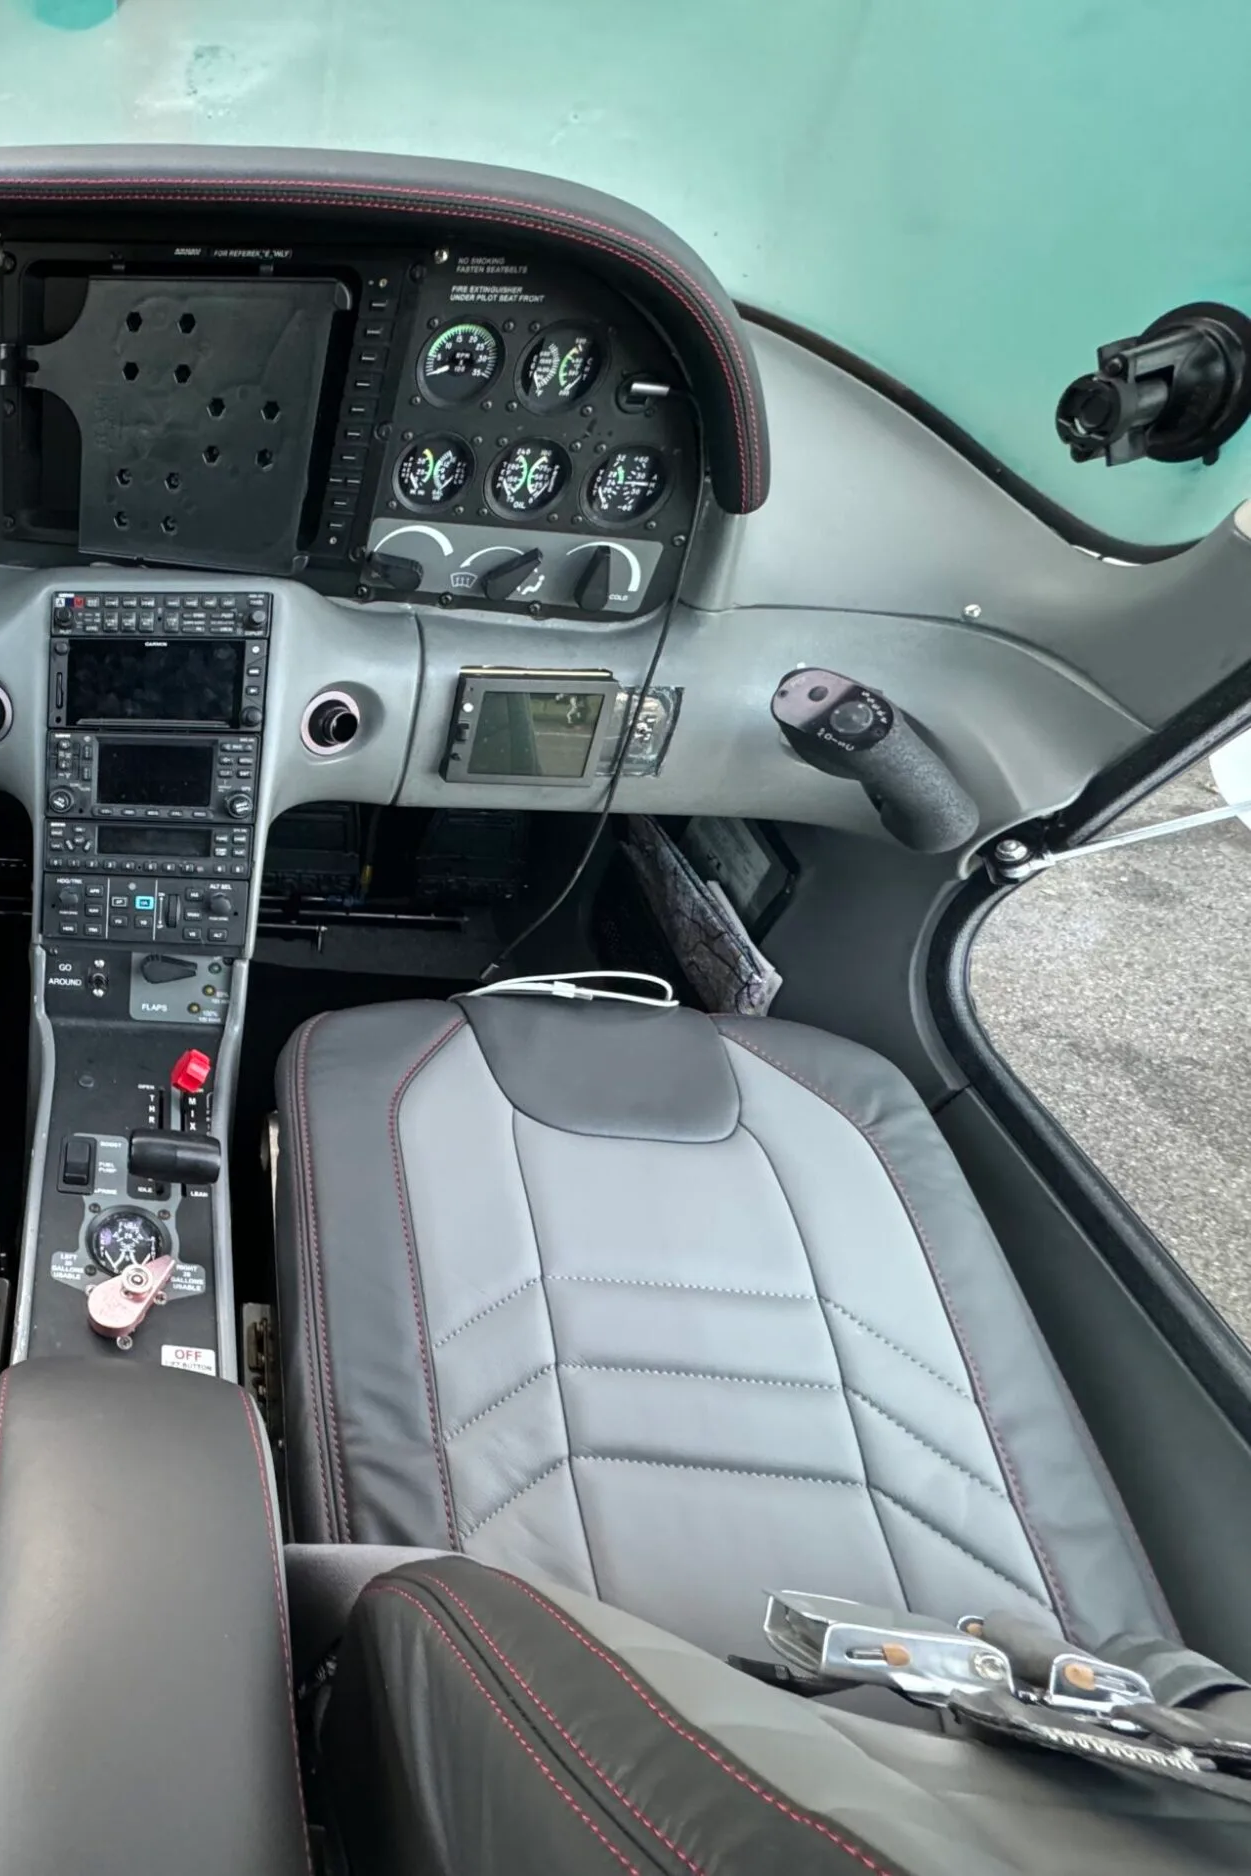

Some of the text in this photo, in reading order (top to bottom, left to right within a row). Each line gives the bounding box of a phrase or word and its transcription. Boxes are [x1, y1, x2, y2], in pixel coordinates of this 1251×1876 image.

[456, 265, 484, 273] FASTEN
[451, 285, 523, 293] FIRE EXTINGUISHER
[456, 335, 463, 343] 15
[469, 335, 478, 343] 20
[475, 343, 485, 351] 25
[513, 501, 526, 509] OIL
[58, 963, 72, 972] GO
[48, 977, 82, 986] AROUND
[141, 1003, 168, 1012] FLAPS
[176, 1264, 198, 1272] RIGHT
[53, 1272, 81, 1280] USABLE
[171, 1277, 204, 1285] GALLONS
[172, 1283, 201, 1292] USABLE
[174, 1349, 202, 1362] OFF
